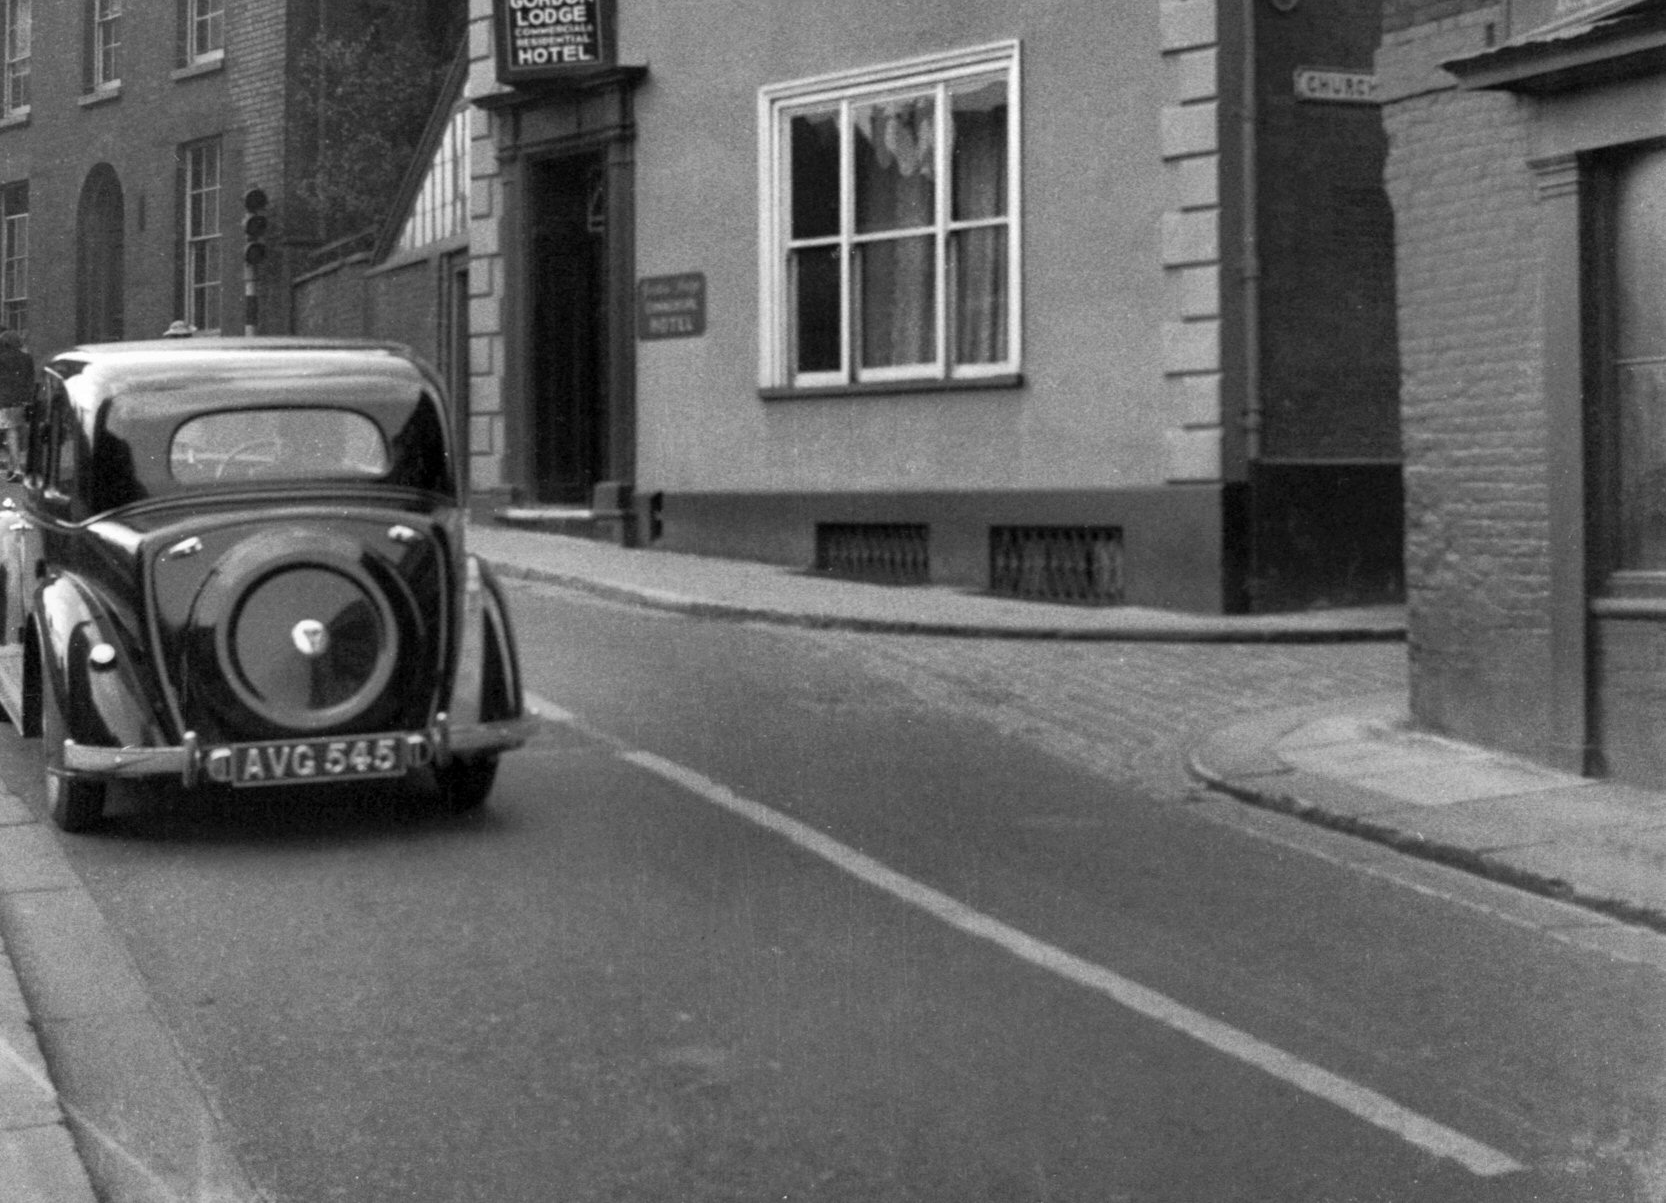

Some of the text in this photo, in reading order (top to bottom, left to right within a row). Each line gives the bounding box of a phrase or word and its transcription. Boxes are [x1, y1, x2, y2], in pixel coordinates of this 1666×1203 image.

[516, 5, 587, 26] LODGE
[516, 34, 590, 48] RESIDENTIAL
[518, 45, 594, 65] HOTEL
[243, 739, 396, 780] AVG 545
